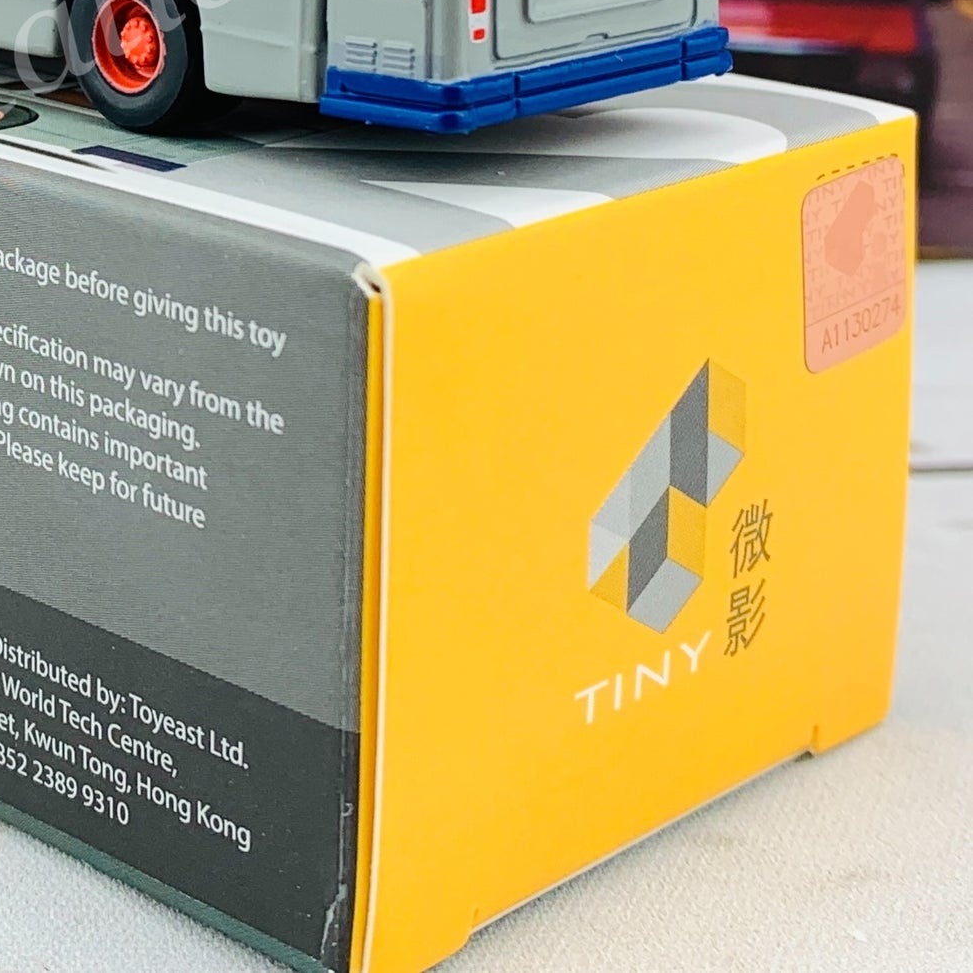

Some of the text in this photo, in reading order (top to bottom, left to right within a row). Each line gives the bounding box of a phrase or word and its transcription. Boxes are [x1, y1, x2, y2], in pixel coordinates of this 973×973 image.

[65, 262, 129, 306] before
[133, 287, 200, 333] giving
[204, 305, 245, 341] this
[249, 321, 288, 358] toy
[821, 293, 902, 355] A1130274
[20, 367, 45, 394] on
[49, 373, 85, 408] this
[89, 390, 201, 453] packaging.
[93, 355, 136, 390] may
[140, 371, 186, 409] vary
[189, 384, 242, 421] from
[246, 399, 285, 436] the
[18, 404, 100, 451] contains
[104, 431, 208, 491] important
[57, 452, 106, 494] keep
[108, 471, 139, 503] for
[141, 483, 206, 529] future
[723, 497, 774, 658] 微影
[96, 677, 126, 714] by:
[128, 692, 205, 751] Toyeast
[210, 729, 250, 769] Ltd.
[574, 632, 713, 726] TINY
[1, 675, 56, 719] World
[59, 699, 103, 737] Tech
[107, 724, 178, 778] Centre,
[24, 718, 76, 763] Kwun
[79, 744, 132, 795] Tong,
[136, 772, 192, 824] Hong
[196, 802, 252, 853] Kong
[32, 762, 78, 800] 2389
[82, 785, 129, 826] 9310
